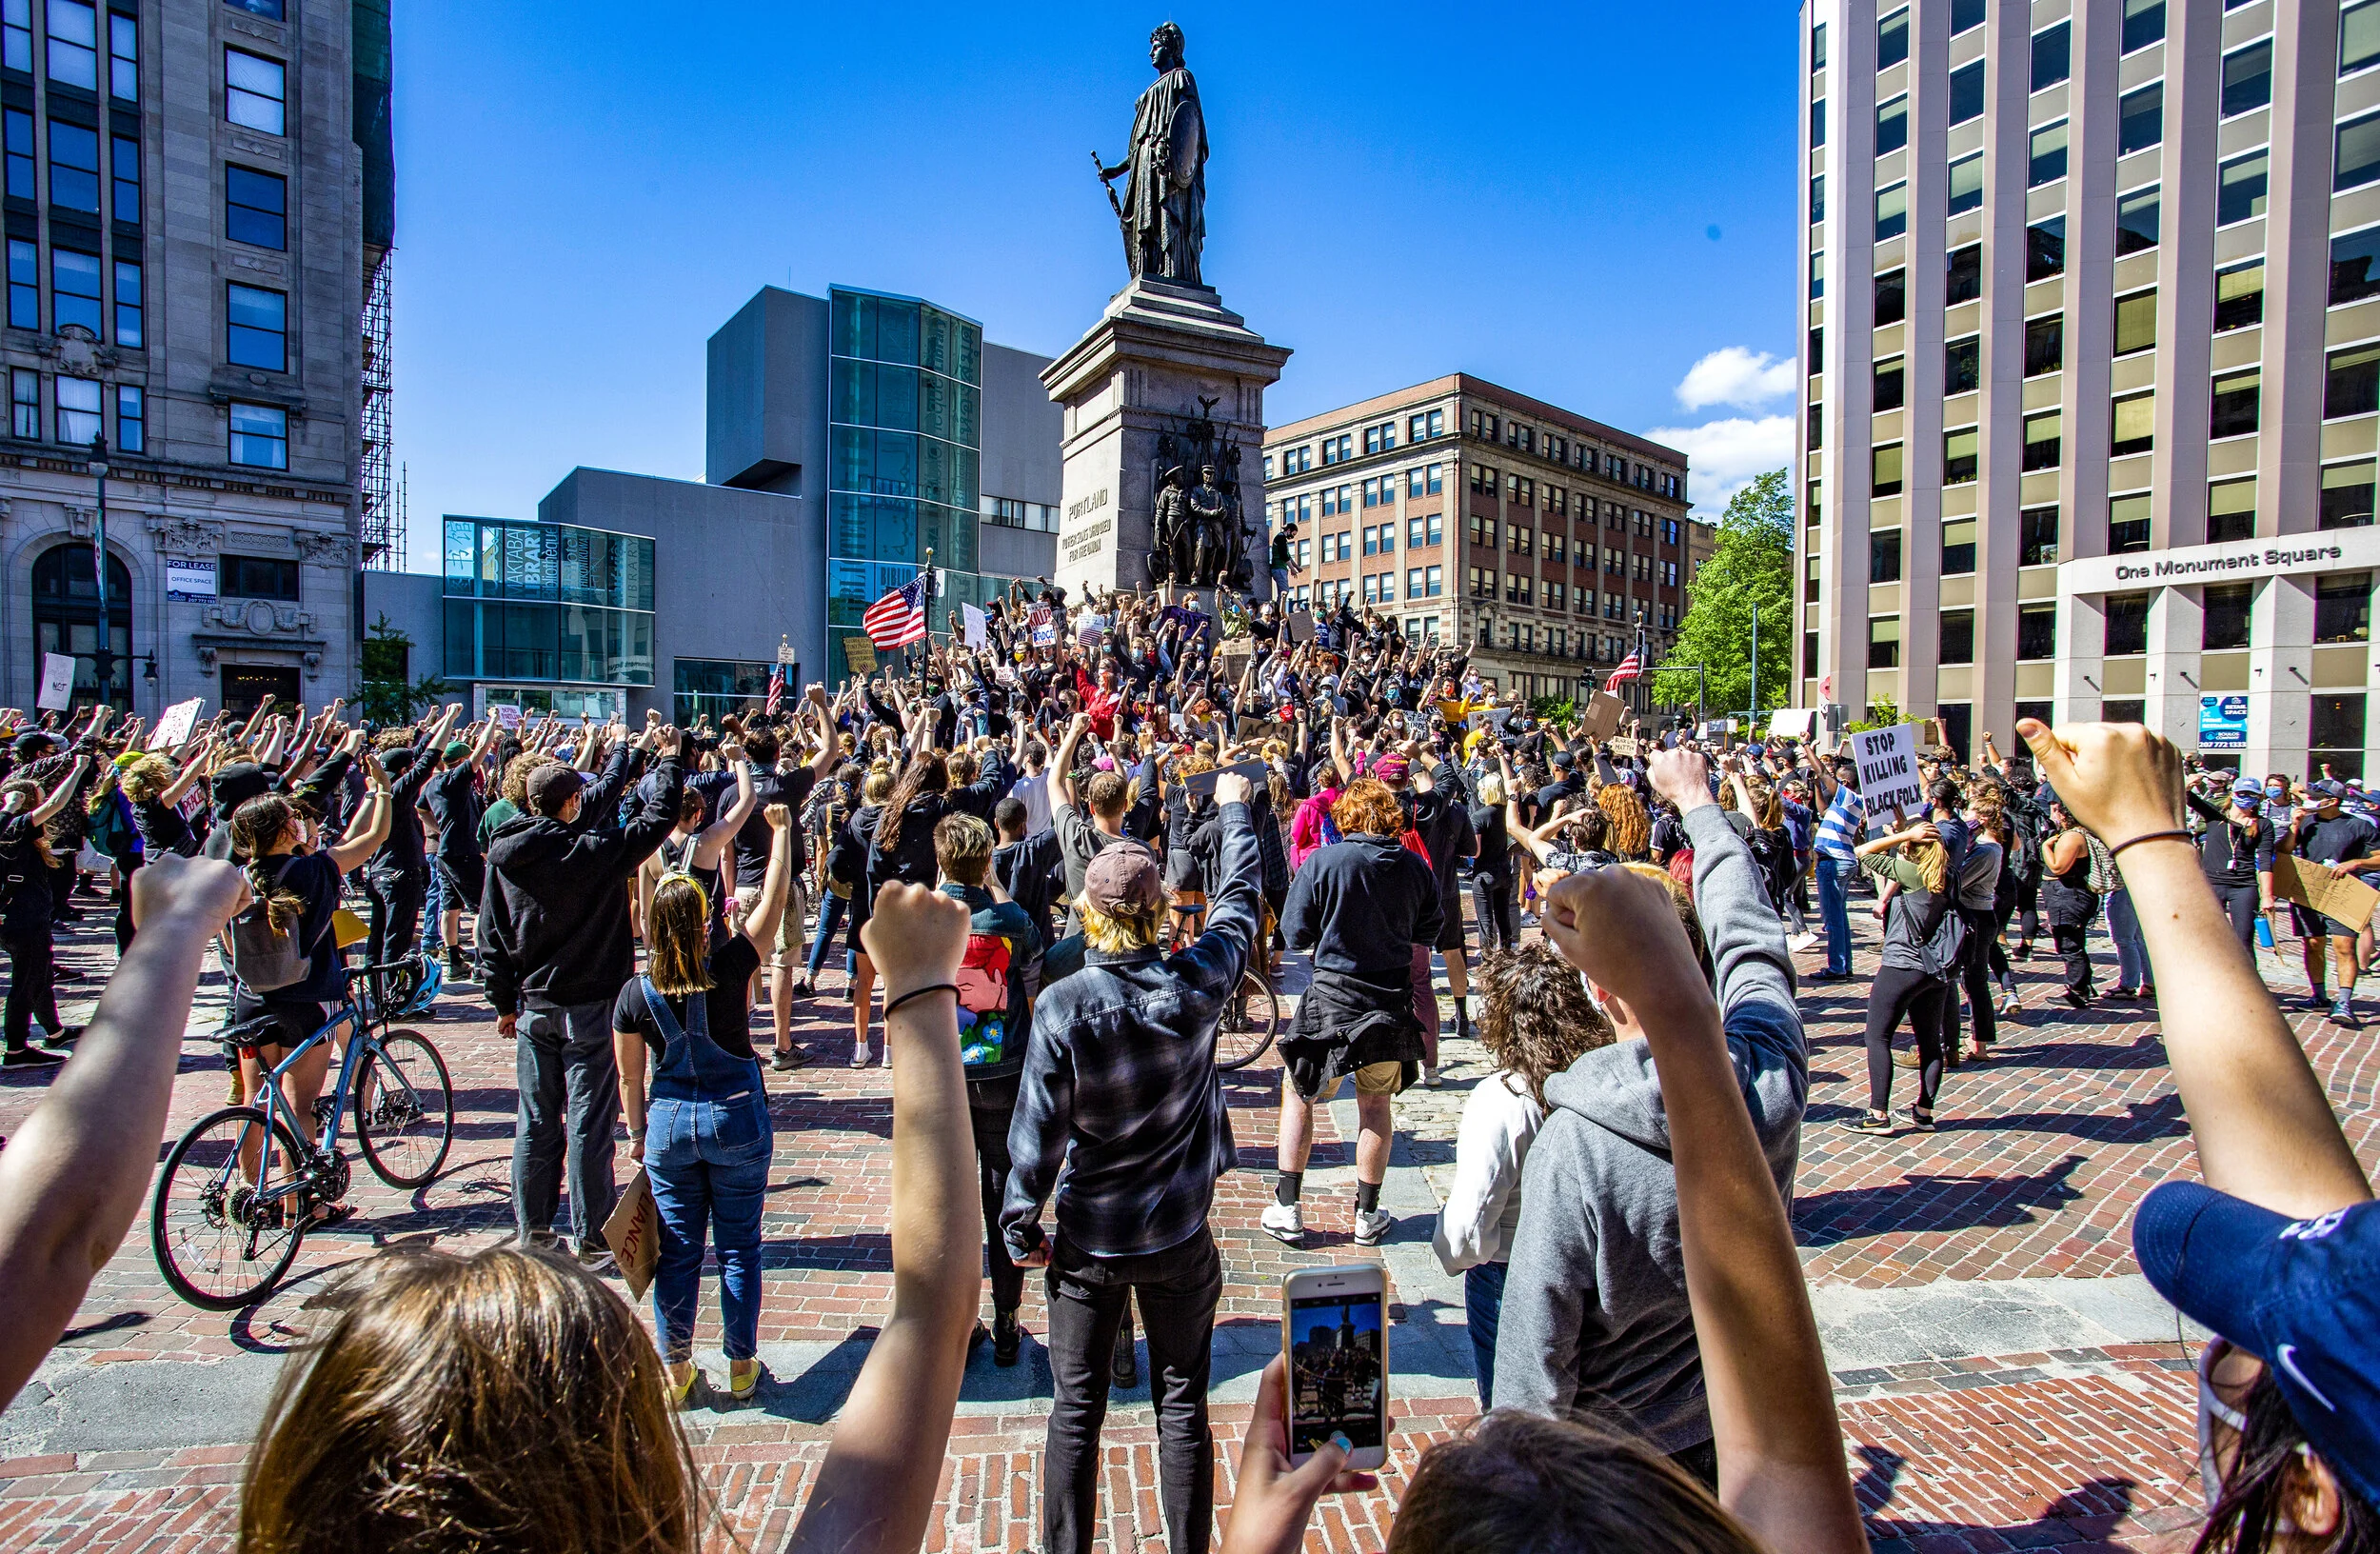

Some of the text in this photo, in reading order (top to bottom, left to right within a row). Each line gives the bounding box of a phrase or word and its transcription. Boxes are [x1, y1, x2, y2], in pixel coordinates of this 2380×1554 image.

[1069, 488, 1108, 522] PORTLAND
[167, 560, 216, 571] FOR LEASE
[525, 528, 541, 599] LIBRARY
[543, 527, 558, 600] Bibliothèque
[627, 538, 637, 609] LIBRARY
[2115, 546, 2341, 579] One Monument Square
[1033, 629, 1054, 642] BADGE
[53, 682, 67, 691] NOT
[1615, 743, 1635, 751] MATTER
[1866, 733, 1895, 756] STOP
[1863, 755, 1908, 785] KILLING
[182, 787, 203, 815] PEACE
[1865, 784, 1923, 817] BLACK FOLX
